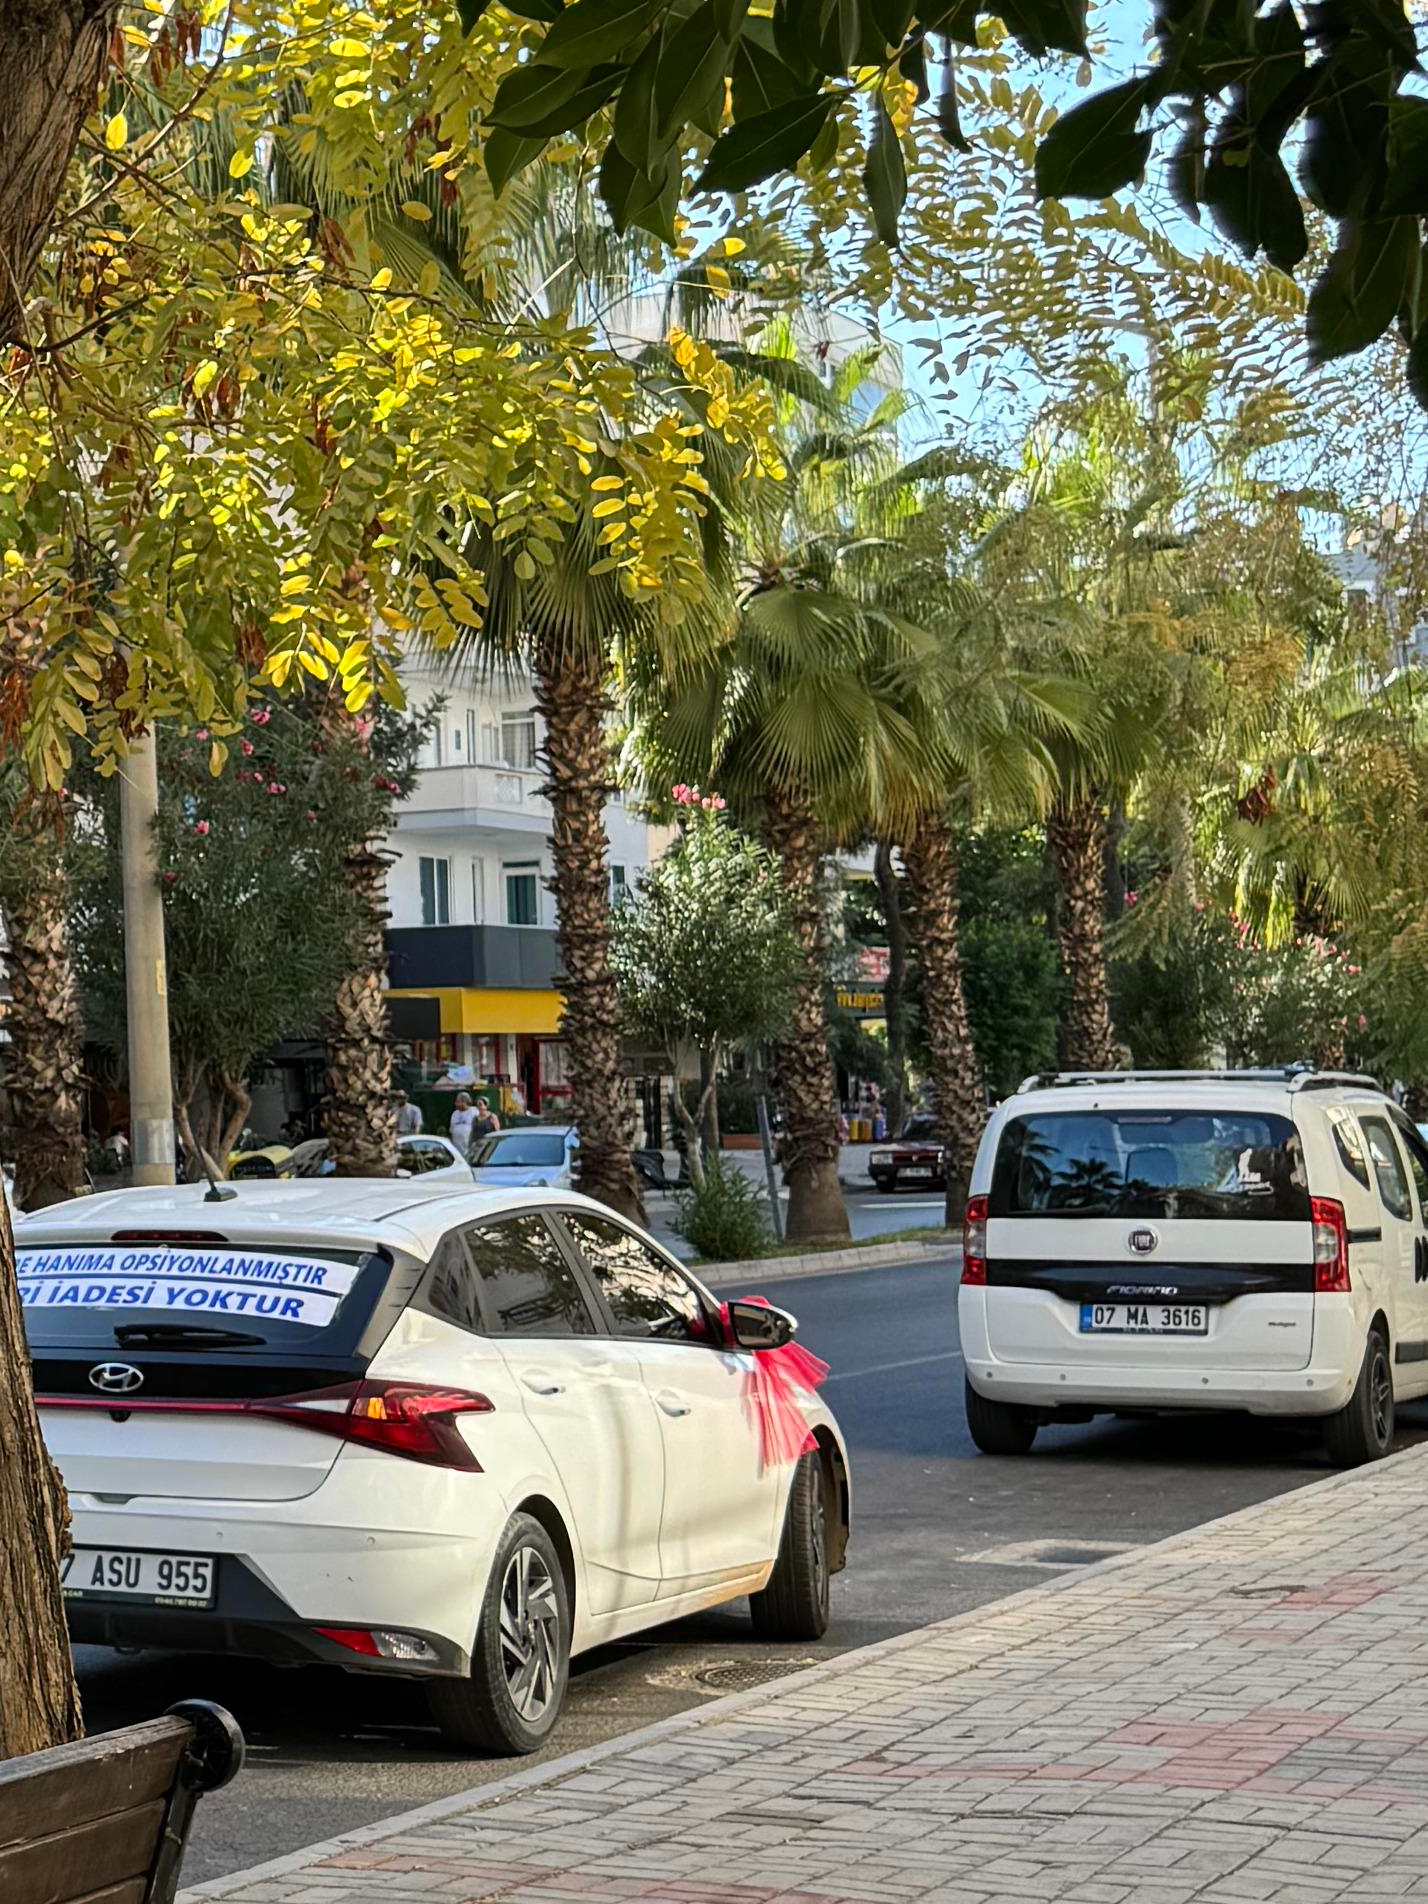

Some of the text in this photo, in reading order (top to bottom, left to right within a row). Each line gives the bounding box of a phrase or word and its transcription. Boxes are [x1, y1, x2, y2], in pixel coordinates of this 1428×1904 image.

[32, 1254, 115, 1273] HANIMA
[120, 1249, 328, 1285] OPSİYONLANMIŞTIR
[47, 1280, 158, 1304] İADESİ
[165, 1287, 305, 1318] YOKTUR
[1094, 1306, 1202, 1326] 07 MA 3616
[91, 1554, 141, 1588] ASU
[156, 1559, 210, 1593] 955
